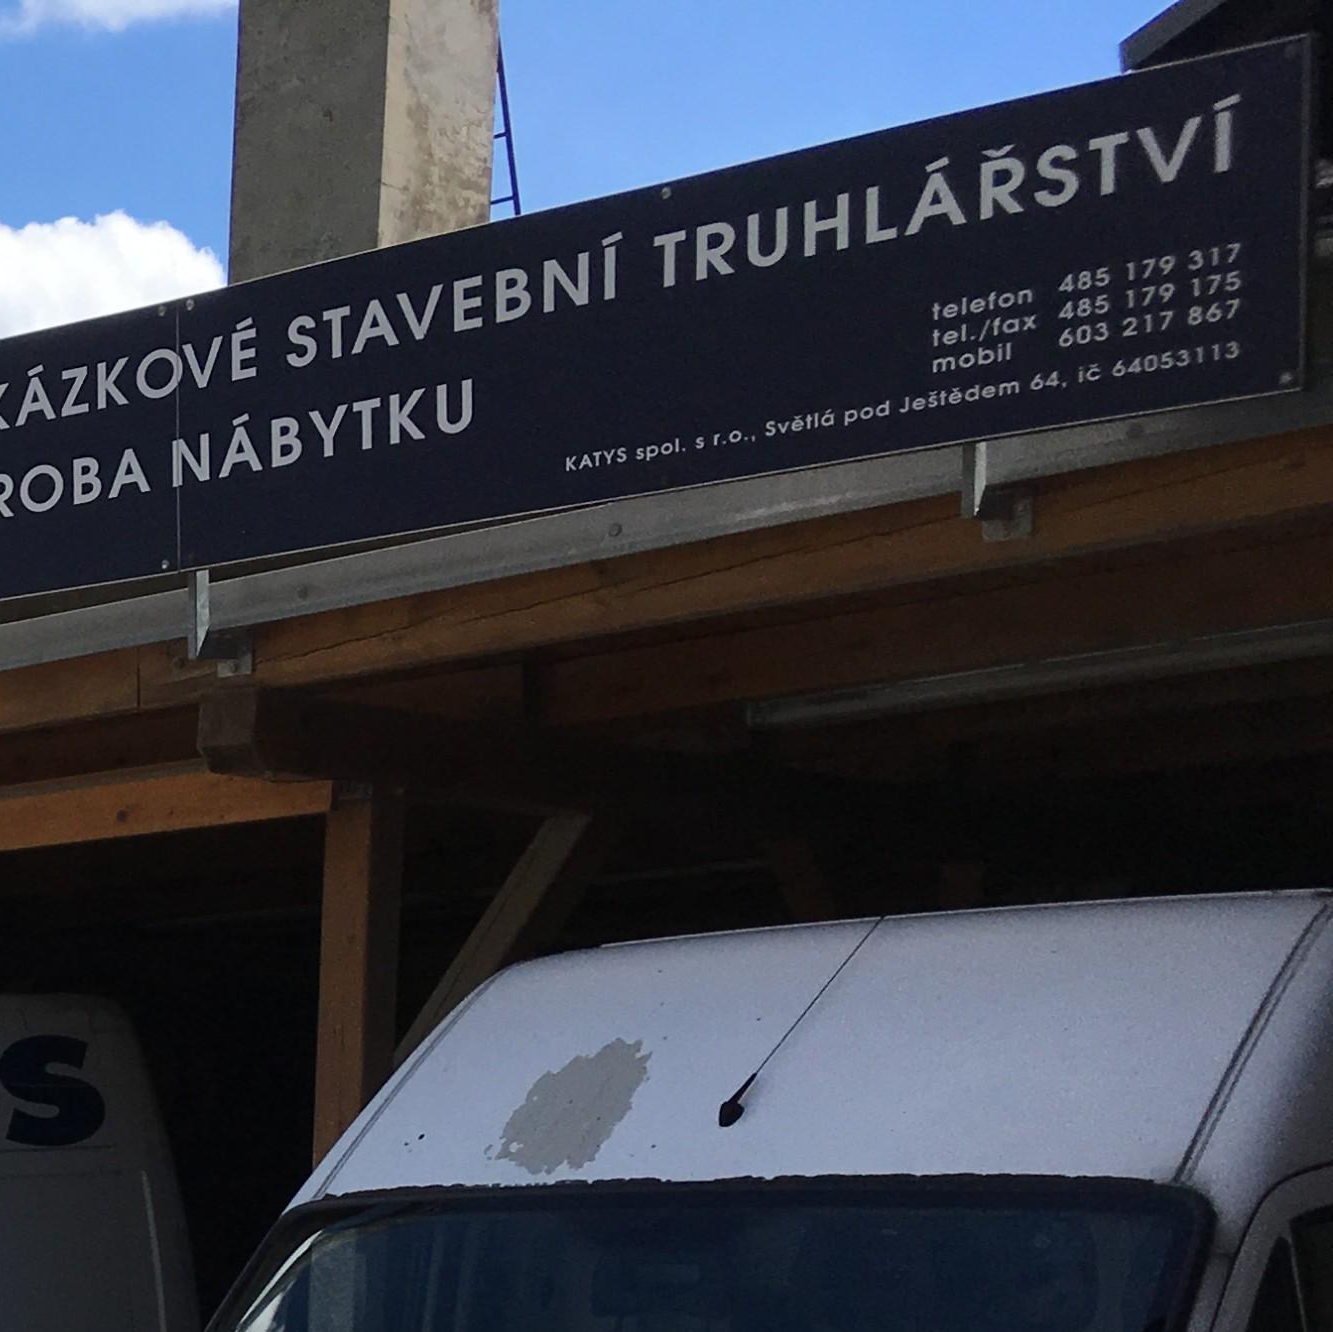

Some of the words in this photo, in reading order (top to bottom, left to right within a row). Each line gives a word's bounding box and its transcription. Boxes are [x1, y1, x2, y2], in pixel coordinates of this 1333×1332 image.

[286, 231, 624, 369] STAVEBNÍ
[653, 93, 1241, 288] TRUHLÁŘSTVÍ
[932, 288, 1033, 321] telefon
[1057, 266, 1110, 293] 485
[1125, 255, 1176, 281] 179
[1187, 242, 1242, 270] 317
[932, 313, 1038, 347] tel./fax
[1057, 294, 1110, 321] 485
[1125, 282, 1175, 309] 179
[1190, 270, 1242, 297] 175
[932, 342, 1013, 373] mobil
[1058, 322, 1110, 348] 603
[1122, 310, 1175, 337] 217
[1187, 298, 1242, 326] 867
[172, 378, 475, 488] NÁBYTKU
[564, 447, 628, 472] KATYS
[635, 438, 686, 462] spol.
[695, 435, 705, 450] s
[713, 429, 756, 446] r.o.,
[764, 408, 835, 437] Světlá
[844, 400, 891, 427] pod
[898, 379, 1021, 414] Ještědem
[1029, 370, 1067, 391] 64,
[1078, 363, 1102, 384] ič
[1111, 340, 1241, 377] 64053113
